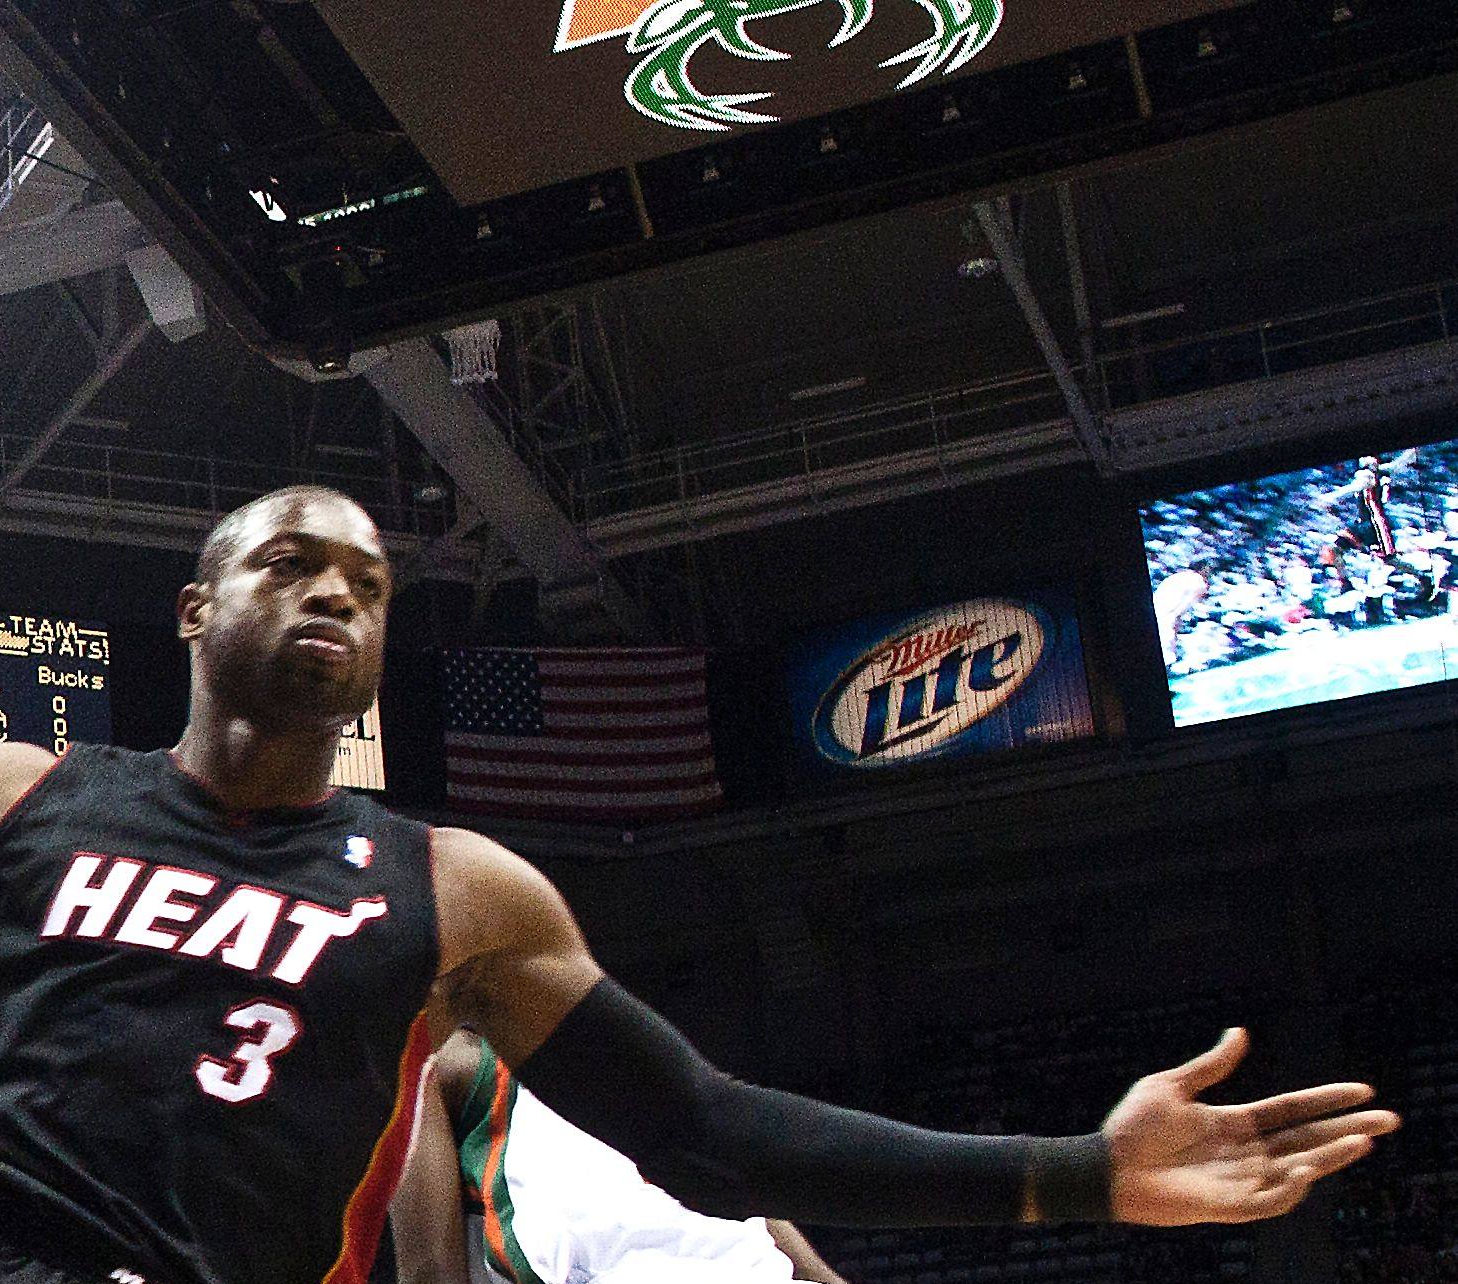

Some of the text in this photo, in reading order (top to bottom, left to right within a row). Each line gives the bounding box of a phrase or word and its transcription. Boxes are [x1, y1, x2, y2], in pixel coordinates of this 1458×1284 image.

[9, 615, 78, 640] TEAM
[30, 635, 110, 665] STATS!
[876, 619, 985, 681] Miller
[52, 695, 66, 714] 0
[858, 629, 1022, 760] Lite
[53, 717, 68, 737] 0
[40, 851, 390, 989] HEAT
[193, 999, 302, 1104] 3
